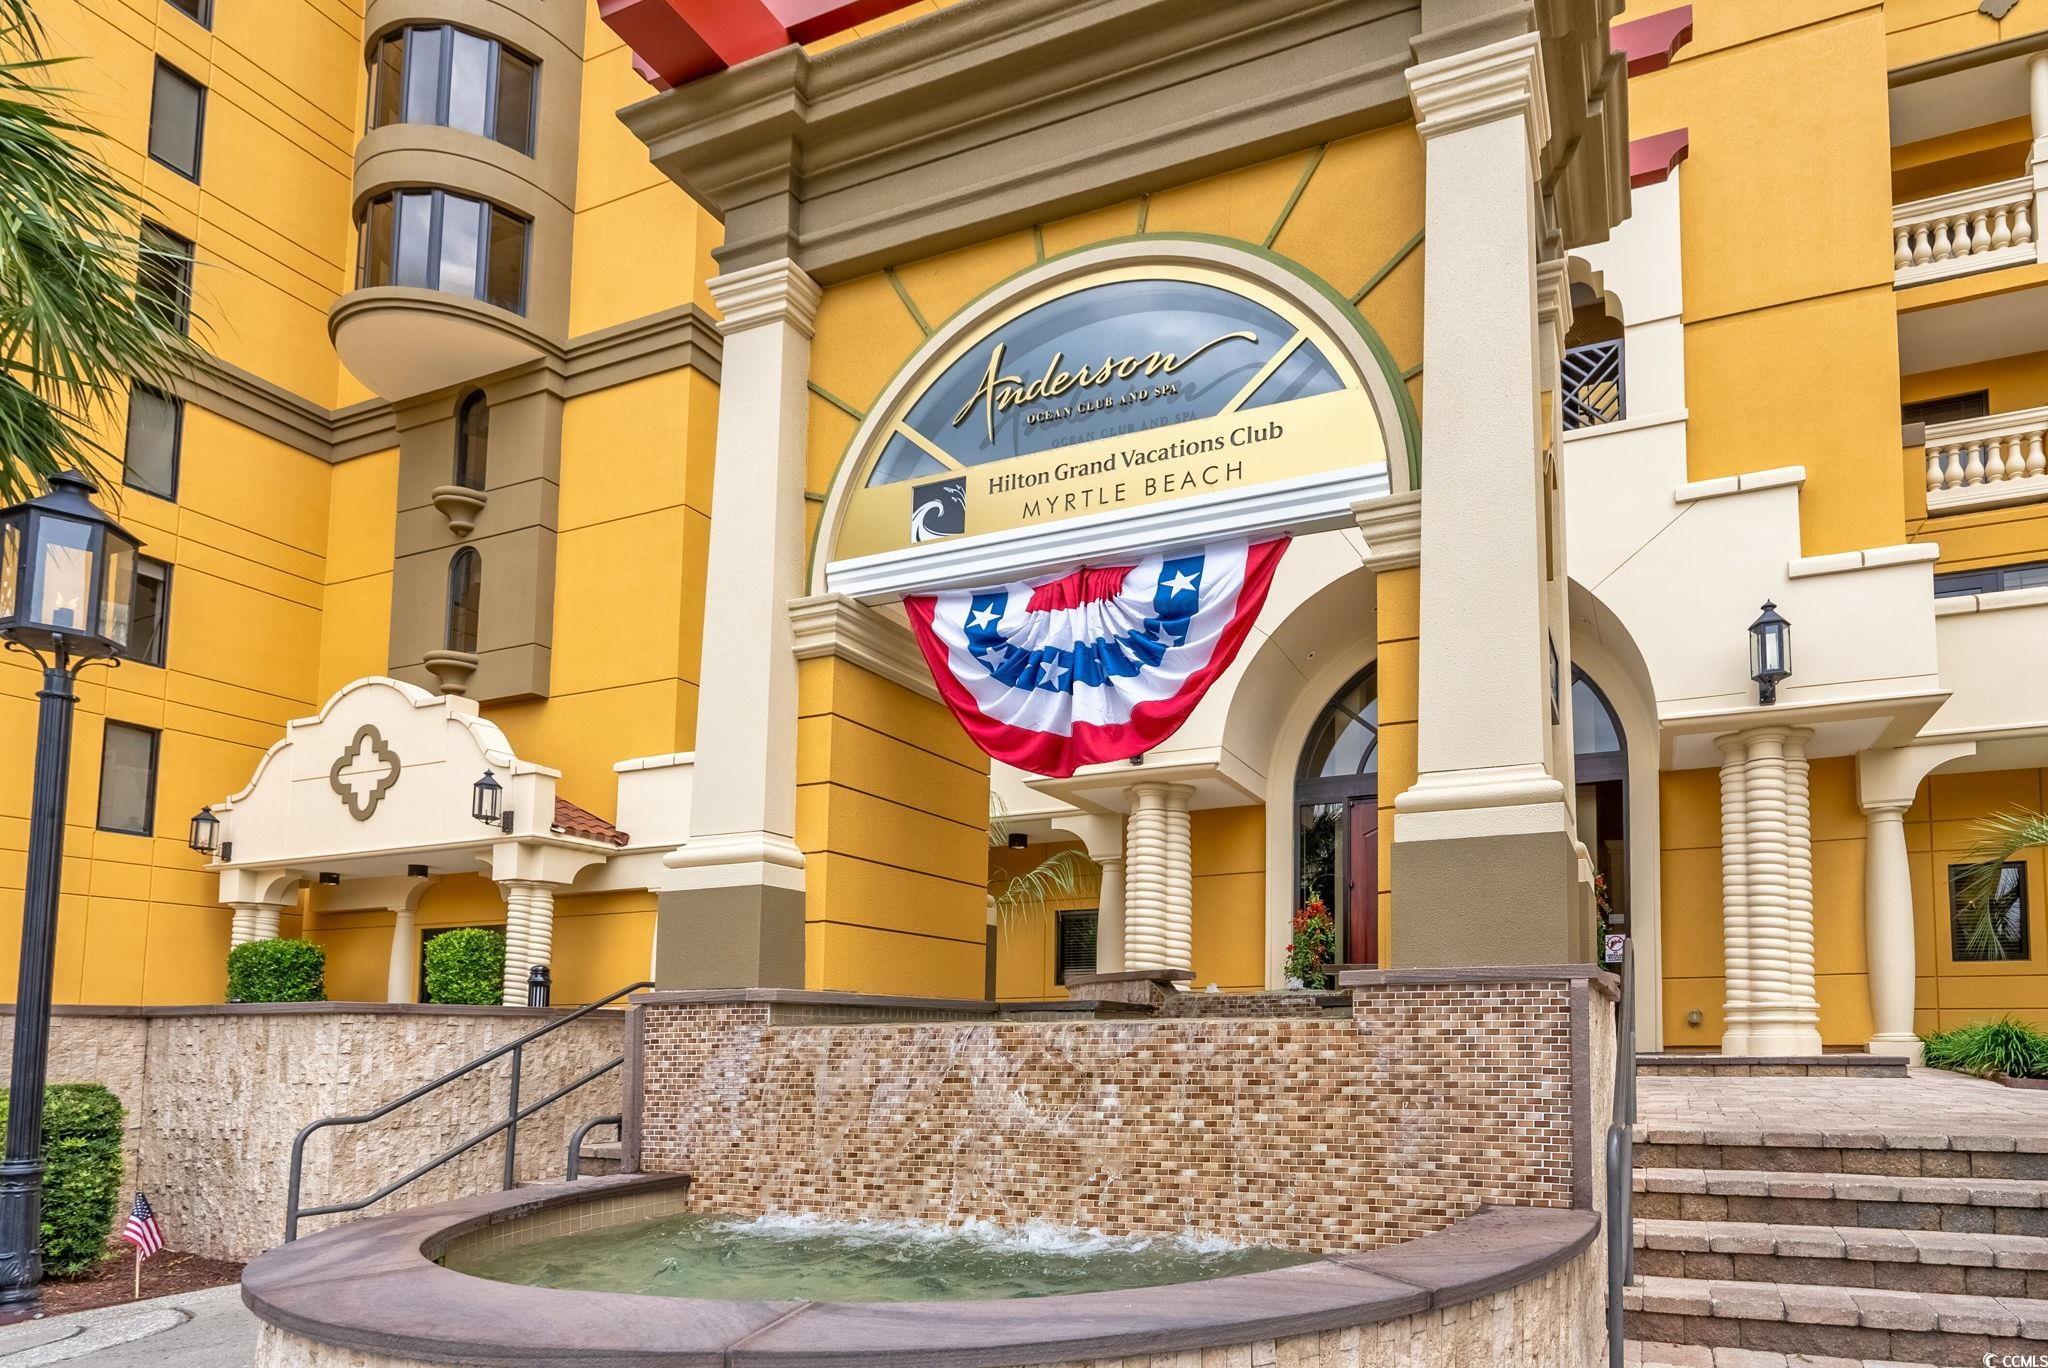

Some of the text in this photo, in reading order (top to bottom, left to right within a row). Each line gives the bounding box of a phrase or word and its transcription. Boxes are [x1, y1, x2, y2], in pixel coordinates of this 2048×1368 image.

[952, 330, 1259, 445] Anderson
[1026, 383, 1178, 425] OCEAN CLUB AND SPA
[988, 421, 1284, 495] Hilton Grand Vacations Club
[1022, 460, 1243, 520] MYRTLE BEACH
